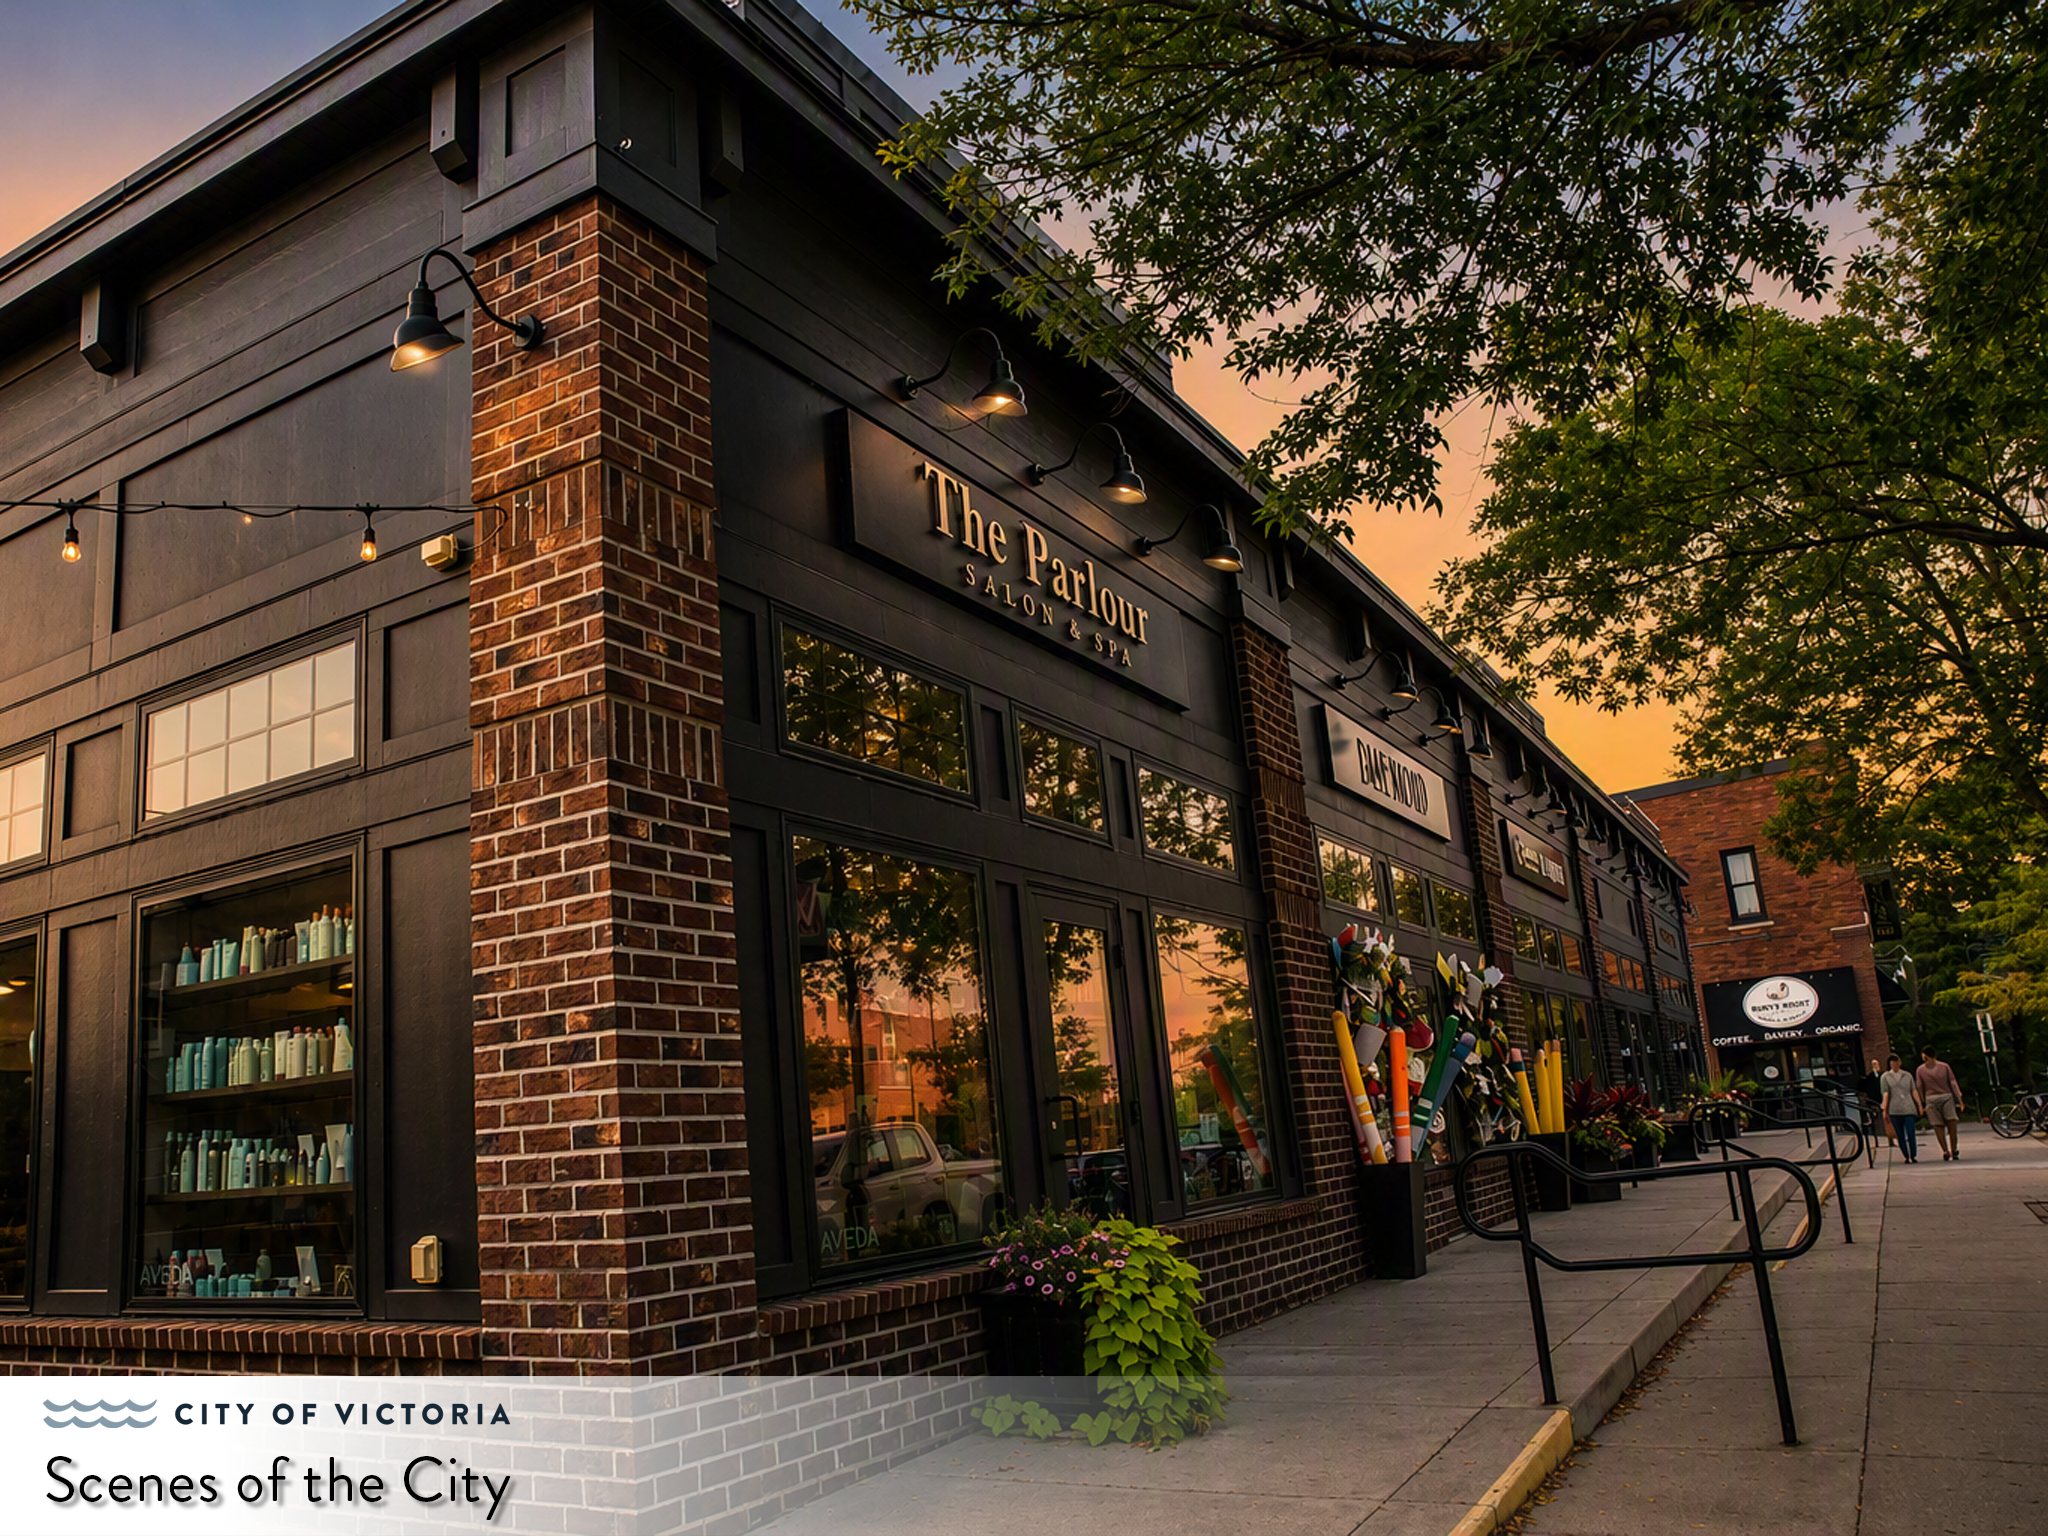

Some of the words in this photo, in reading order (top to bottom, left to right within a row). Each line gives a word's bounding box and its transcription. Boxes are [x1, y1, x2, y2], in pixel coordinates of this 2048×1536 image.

[923, 460, 1008, 564] The
[1020, 520, 1149, 645] Parlour
[965, 563, 1054, 626] SALON
[1069, 618, 1081, 641] &
[1094, 631, 1133, 667] SPA
[820, 1225, 880, 1254] AVEDA
[139, 1264, 194, 1286] AVEDA
